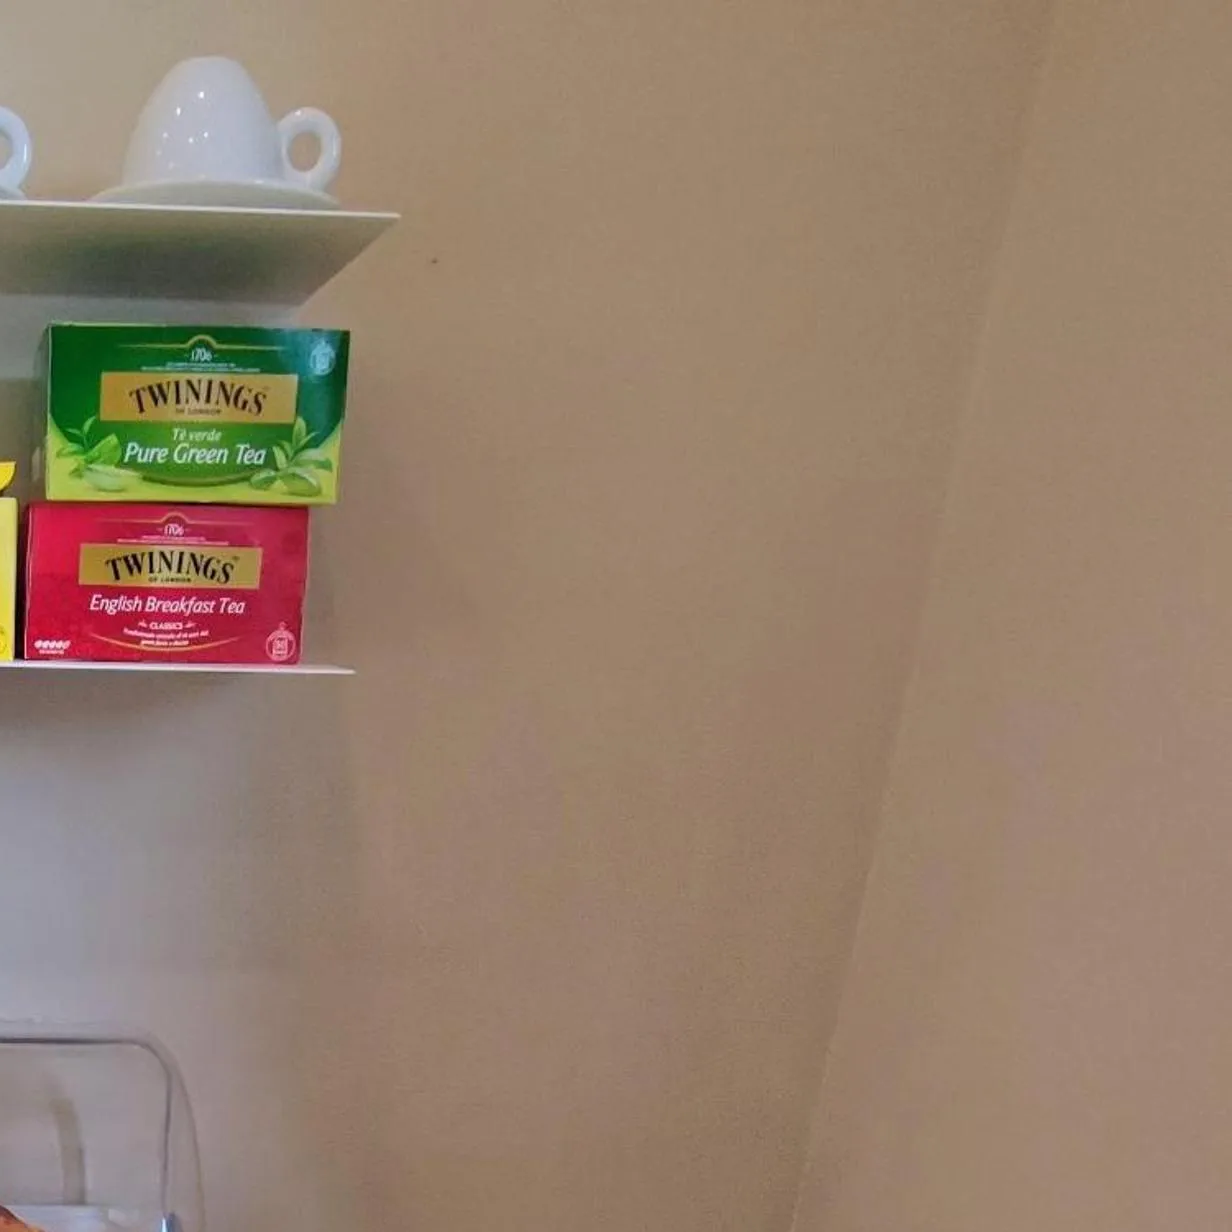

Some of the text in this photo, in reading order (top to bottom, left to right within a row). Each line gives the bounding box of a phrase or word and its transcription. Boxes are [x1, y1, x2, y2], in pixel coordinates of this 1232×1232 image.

[129, 379, 266, 416] TWININGS
[172, 428, 222, 441] Tè verde
[124, 443, 266, 465] Pure Green Tea
[104, 550, 234, 585] TWININGS
[89, 594, 246, 615] English Breakfast Tea
